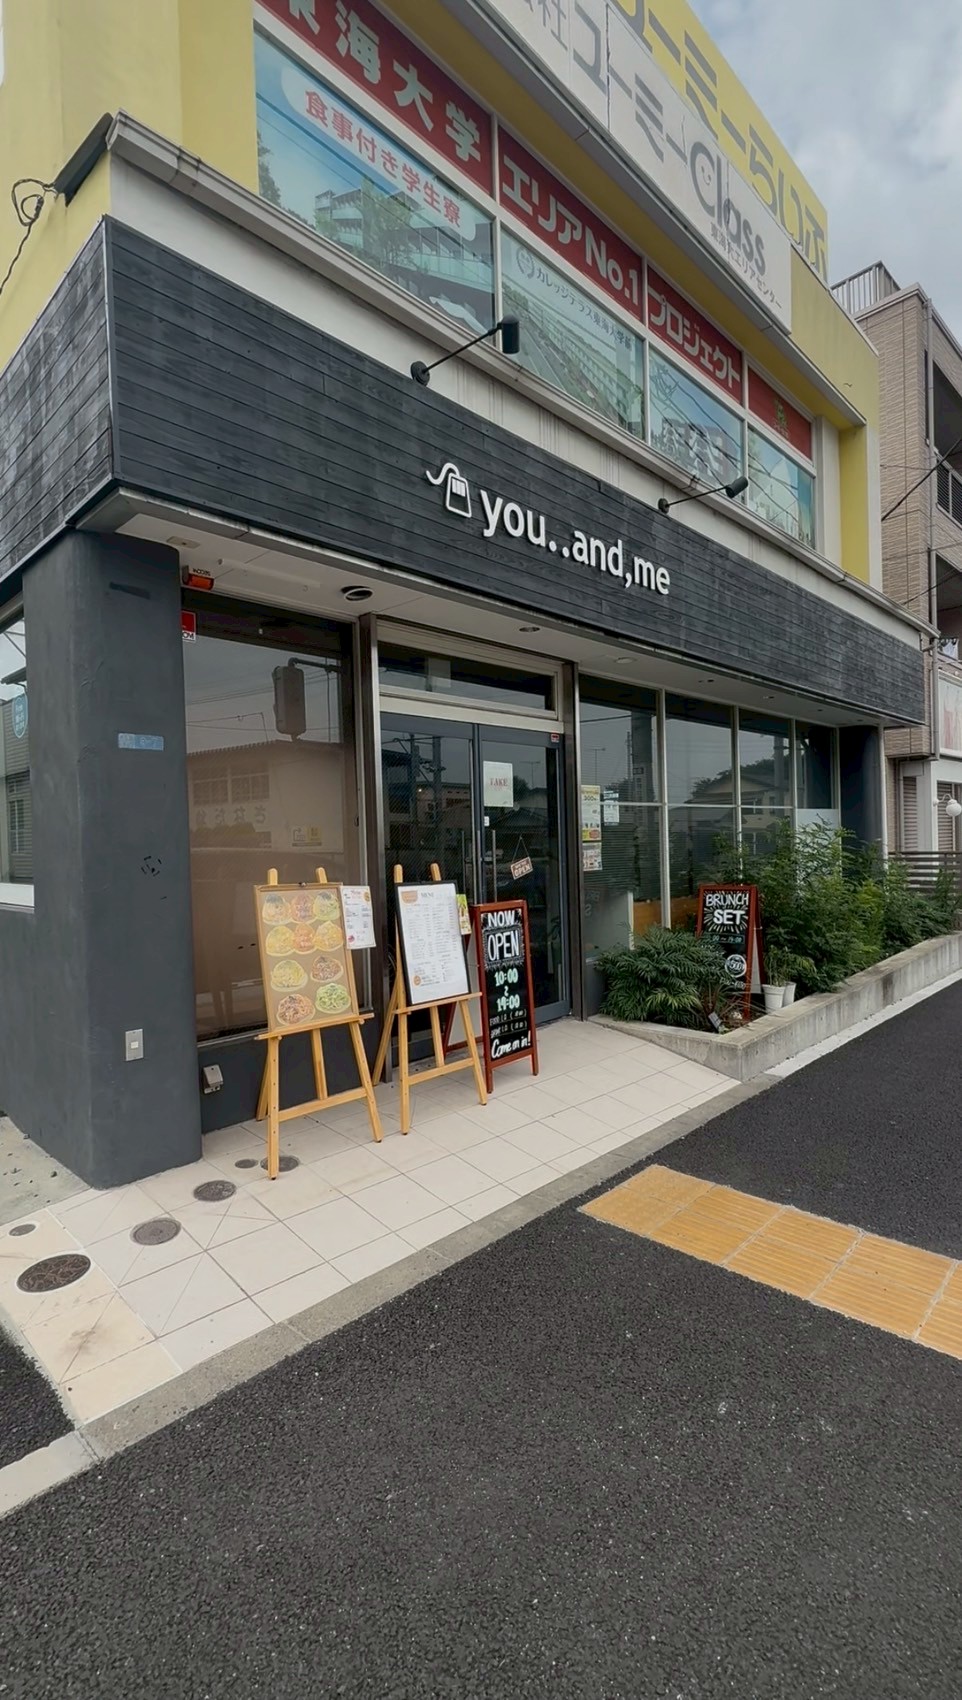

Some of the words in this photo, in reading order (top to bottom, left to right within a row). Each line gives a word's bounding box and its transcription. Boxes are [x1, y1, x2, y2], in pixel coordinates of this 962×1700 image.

[305, 90, 461, 229] 食事付き学生寮
[648, 284, 740, 389] プロジェクト
[706, 893, 749, 907] BRUNCH
[488, 910, 515, 927] NOW
[713, 909, 746, 925] SET
[487, 930, 520, 961] OPEN
[494, 967, 519, 987] 10:00
[491, 1038, 512, 1059] Come
